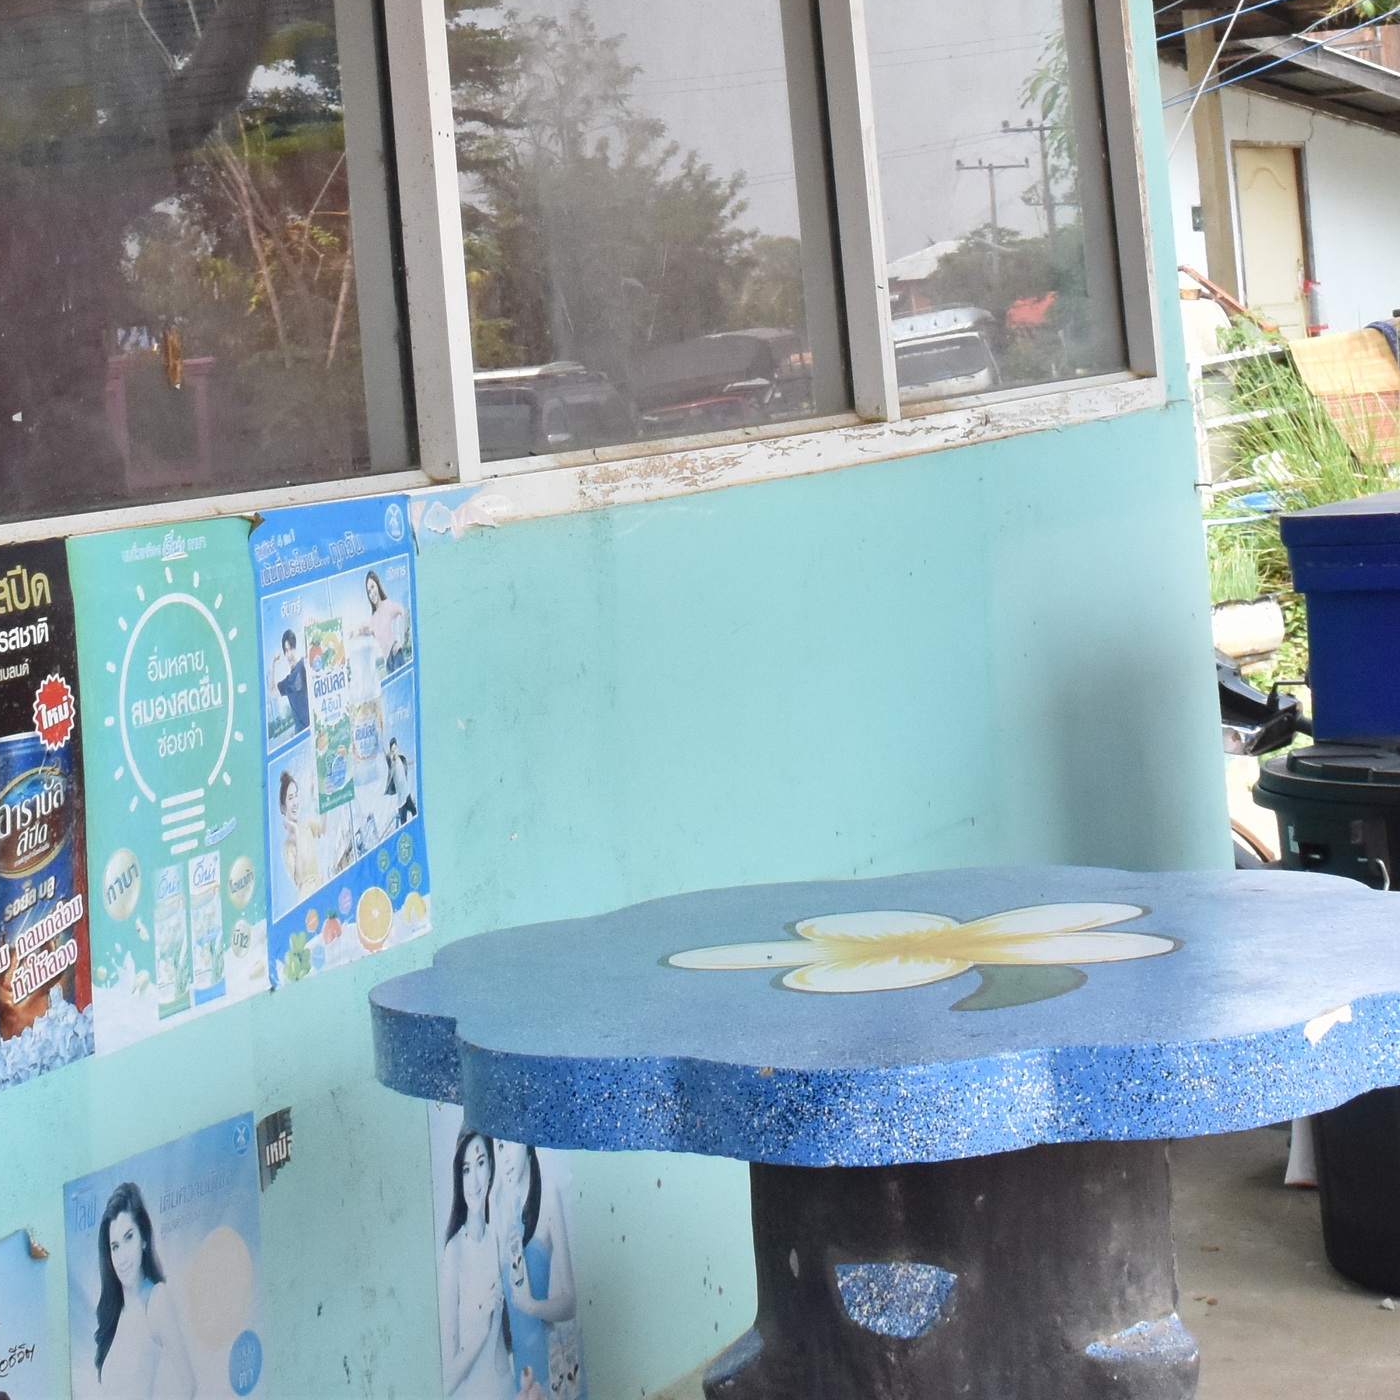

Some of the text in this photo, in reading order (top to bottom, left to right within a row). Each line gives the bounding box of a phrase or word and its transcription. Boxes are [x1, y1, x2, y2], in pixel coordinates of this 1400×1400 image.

[37, 696, 70, 730] ใหม่
[131, 666, 223, 727] สมองสดชื่น
[15, 893, 83, 961] กลมกล่อม
[11, 939, 78, 1004] ท้าให้ลอง
